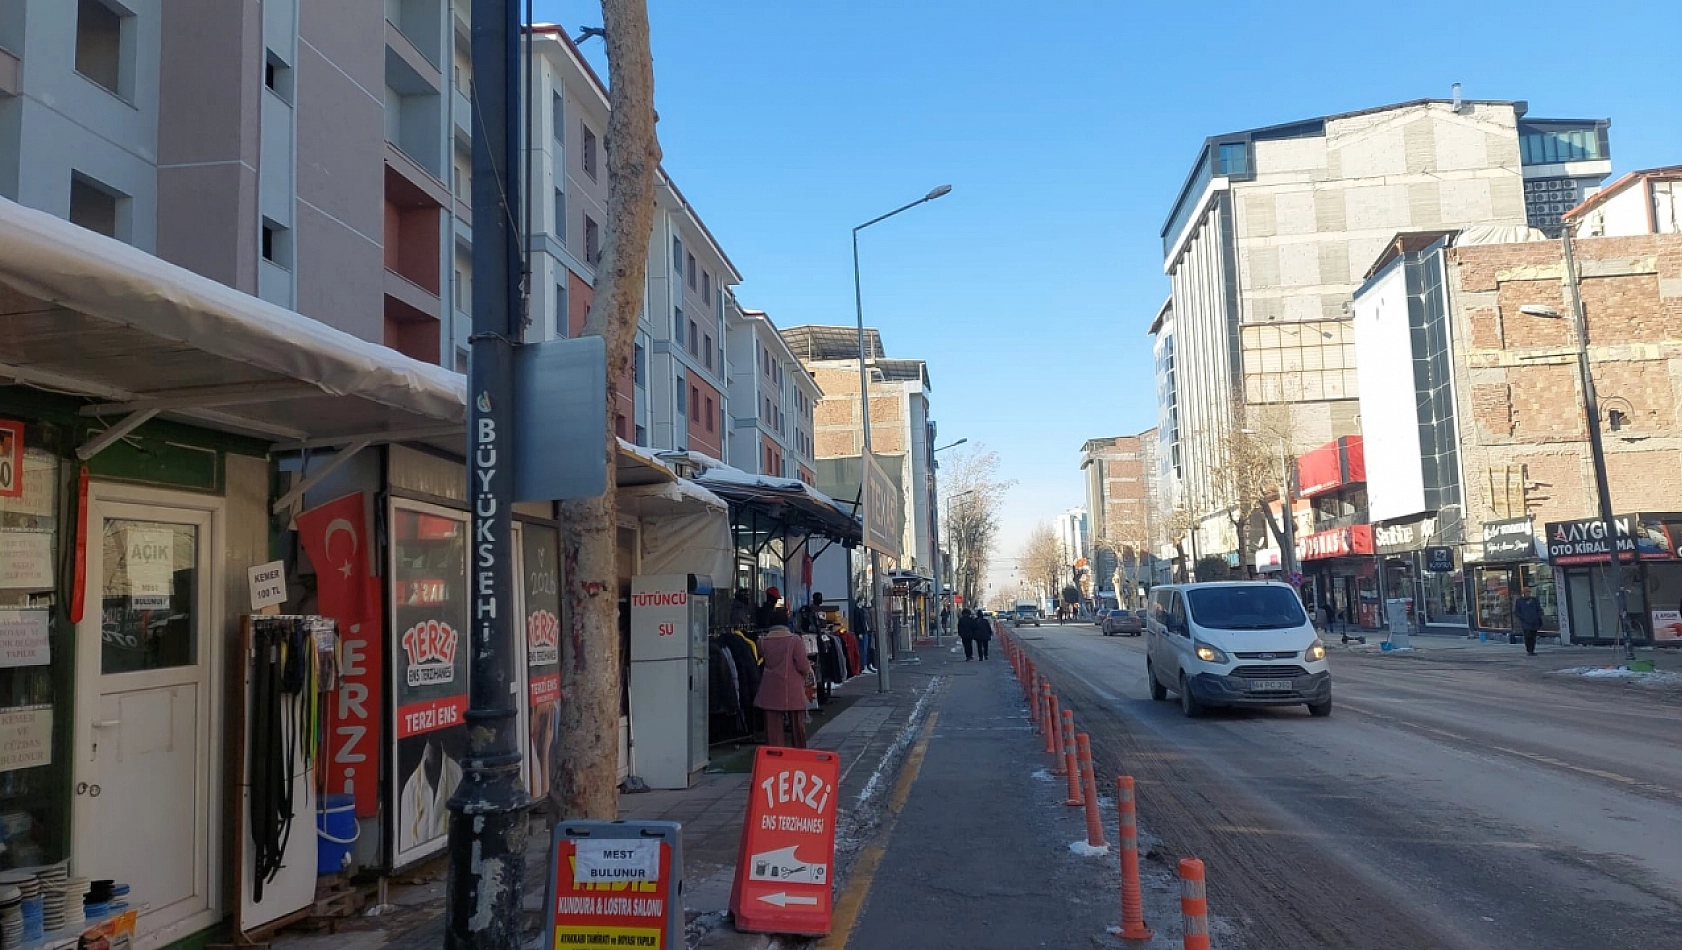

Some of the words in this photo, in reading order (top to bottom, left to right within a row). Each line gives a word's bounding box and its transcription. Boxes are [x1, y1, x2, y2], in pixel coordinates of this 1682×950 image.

[132, 544, 168, 563] AÇIK
[1551, 544, 1573, 556] OTO
[1576, 539, 1636, 554] KİRALMA
[254, 569, 280, 583] KEMER
[257, 588, 270, 599] 100
[272, 586, 281, 596] TL
[632, 590, 687, 607] TÜTÜNCÜ
[659, 623, 674, 636] SU
[405, 703, 436, 732] TERZİ
[438, 705, 457, 725] ENS
[762, 815, 776, 830] ENS
[603, 850, 634, 859] MEST
[590, 869, 646, 877] BULUNUR
[558, 896, 594, 914] KUNDURA
[595, 897, 603, 915] &
[604, 897, 632, 916] LOSTRA
[633, 899, 663, 917] SALONU
